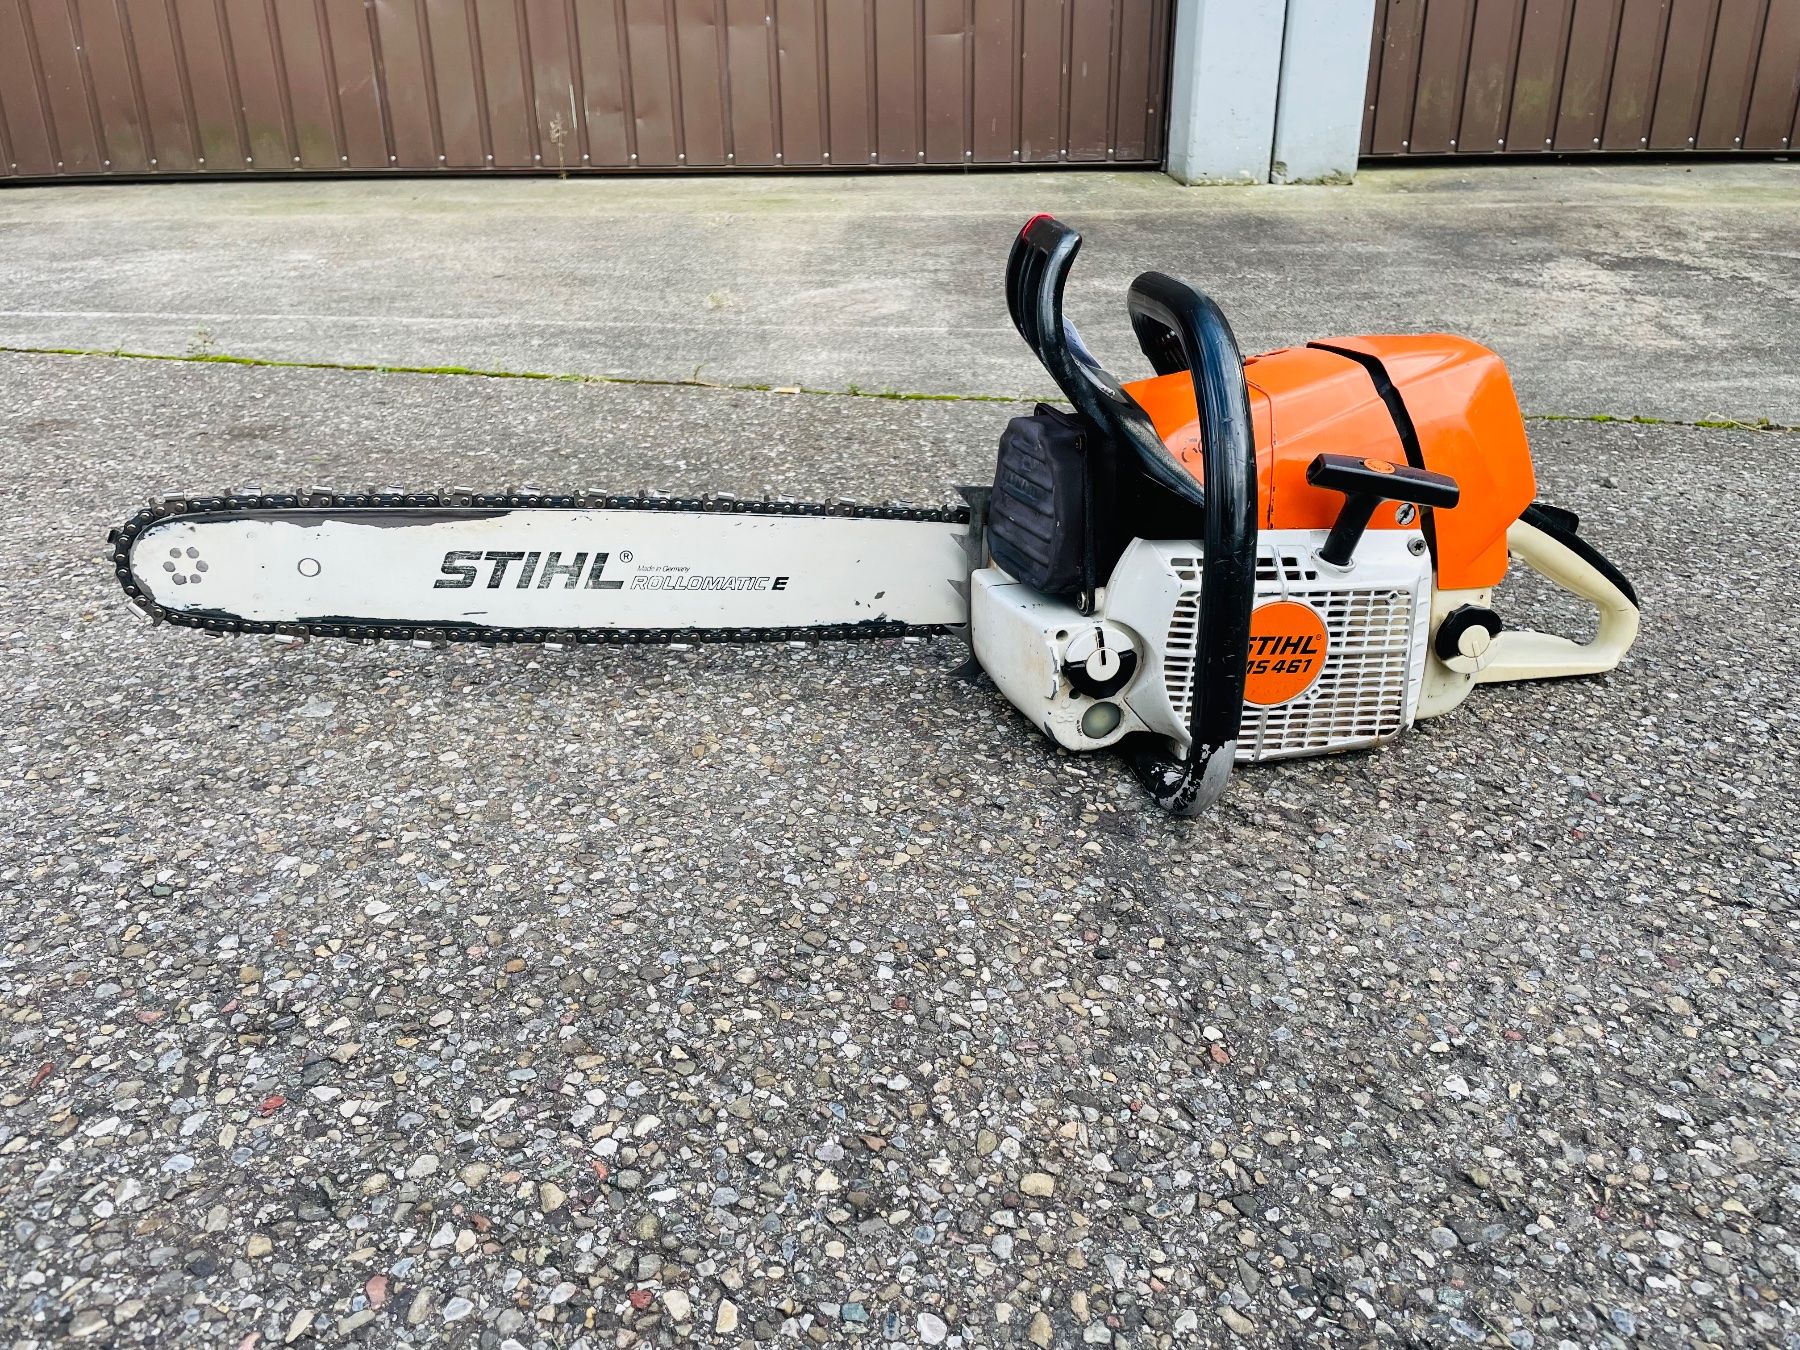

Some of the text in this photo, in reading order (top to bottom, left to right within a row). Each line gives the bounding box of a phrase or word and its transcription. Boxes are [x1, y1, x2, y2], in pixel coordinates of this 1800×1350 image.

[662, 565, 691, 574] Germany
[630, 575, 790, 591] ROLLOMATIC E
[1271, 658, 1313, 674] 461
